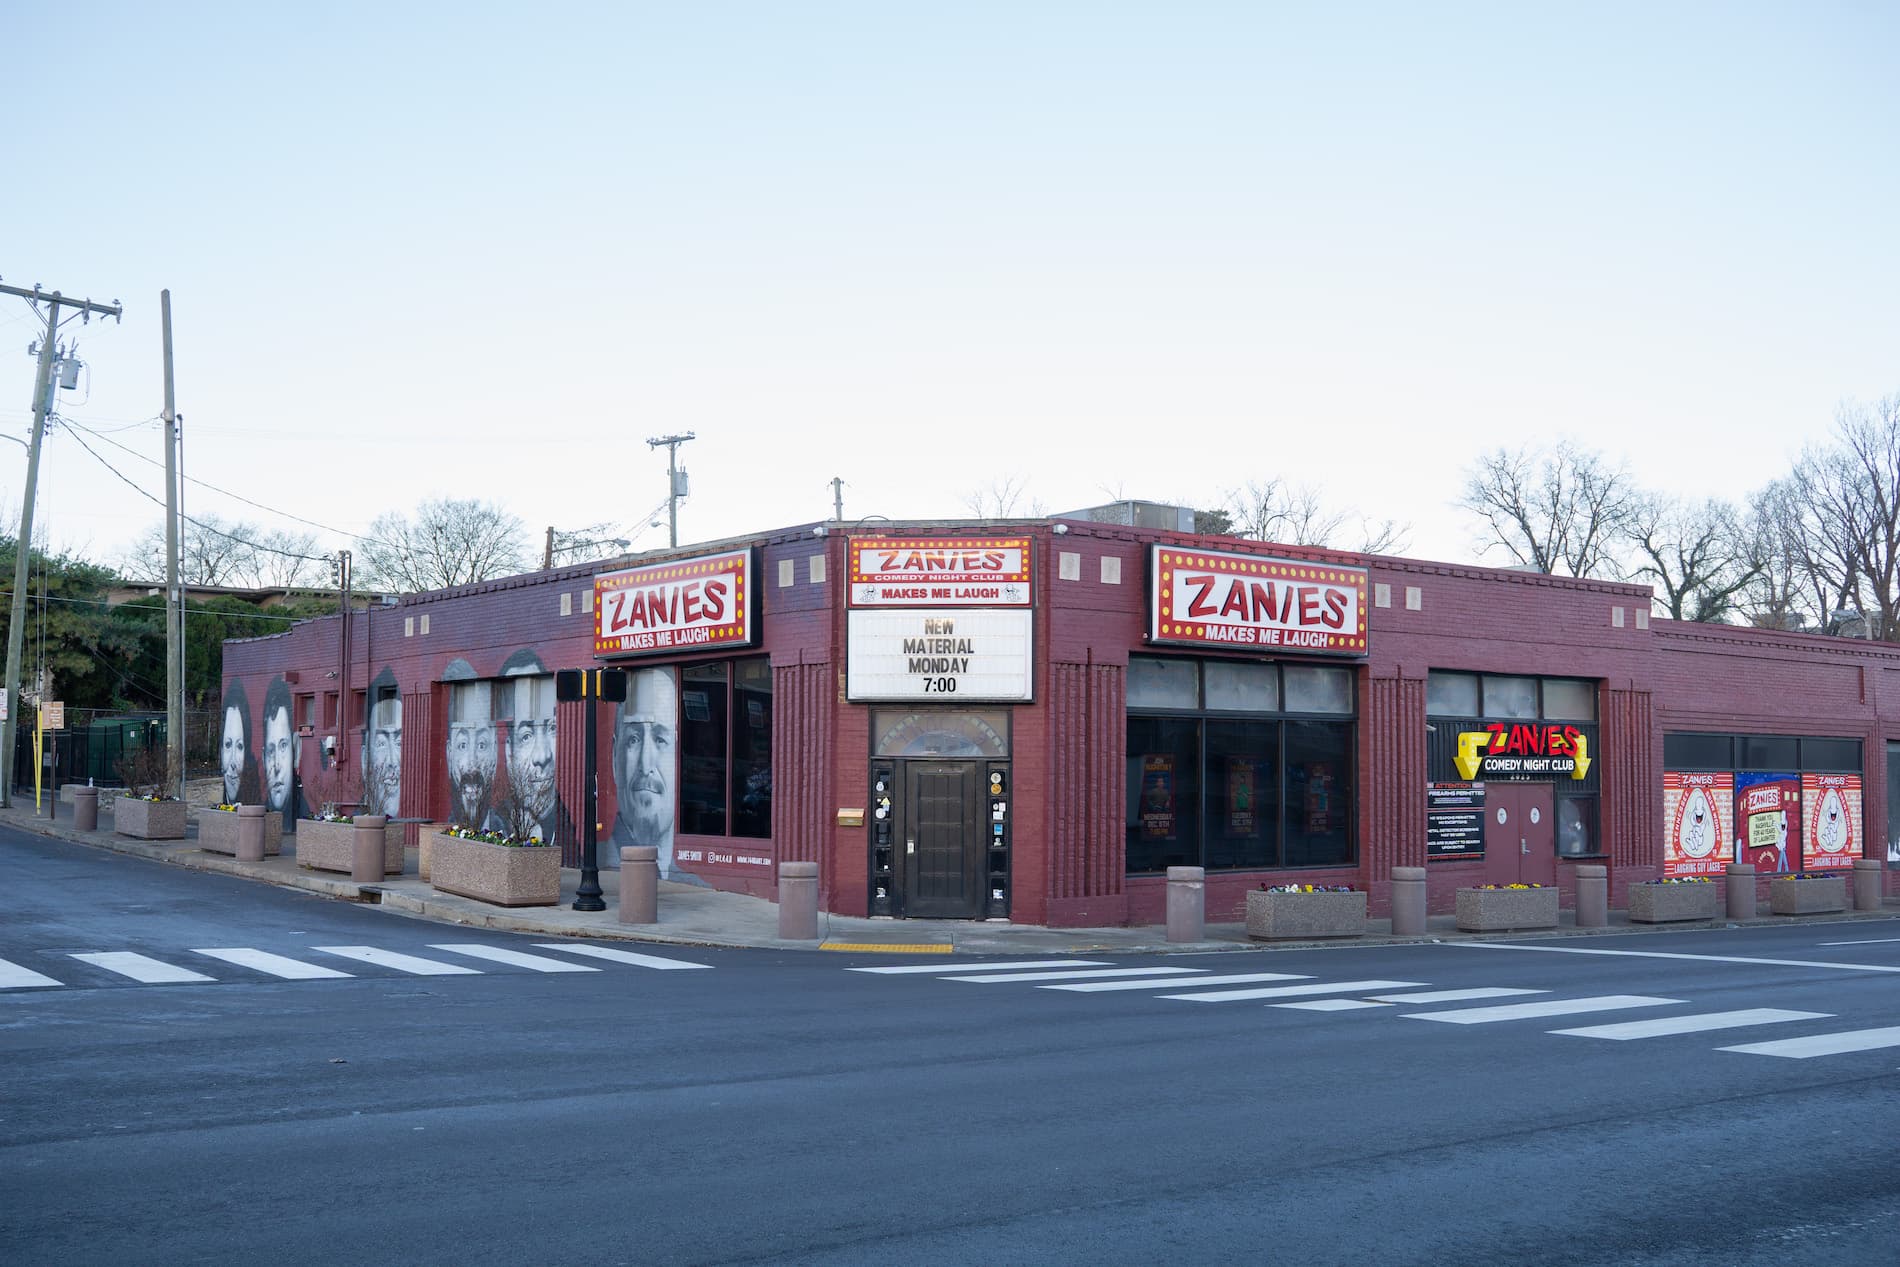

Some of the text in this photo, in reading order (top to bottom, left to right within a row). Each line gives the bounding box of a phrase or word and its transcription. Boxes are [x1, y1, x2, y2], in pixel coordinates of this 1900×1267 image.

[878, 550, 1006, 572] ZANIES
[882, 588, 1000, 598] MAKES ME LAUGH
[608, 579, 728, 633] ZANIES
[1185, 575, 1349, 630] ZANIES
[924, 618, 954, 635] NEW
[620, 627, 710, 650] MAKES ME LAUGH
[1205, 624, 1328, 648] MAKES ME LAUGH
[903, 638, 974, 654] MATERIAL
[908, 657, 969, 674] MONDAY
[923, 677, 956, 693] 7:00
[1486, 723, 1580, 757] ZANIES
[1484, 759, 1574, 770] COMEDY NIGHT CLUB
[1682, 775, 1713, 784] ZANIES
[1818, 776, 1846, 785] ZANIES
[1750, 791, 1777, 808] ZANIES
[1673, 790, 1690, 843] TENNESSEE
[1675, 863, 1696, 873] LAUGHING
